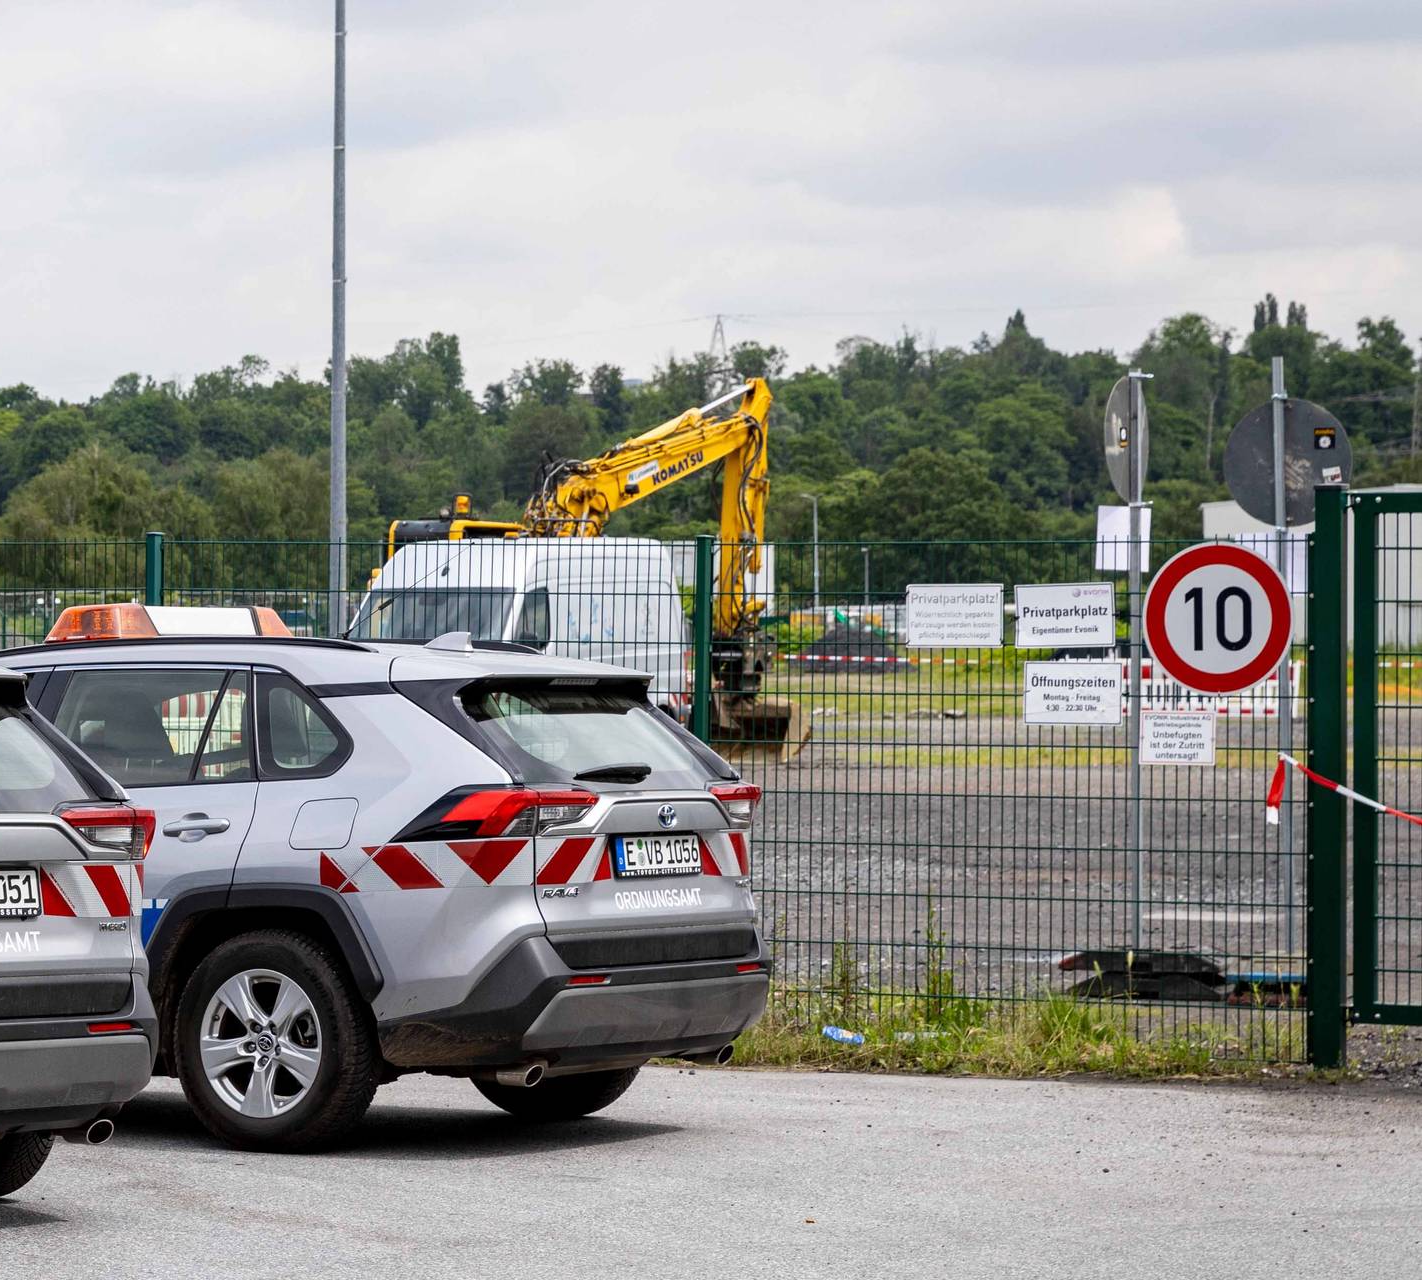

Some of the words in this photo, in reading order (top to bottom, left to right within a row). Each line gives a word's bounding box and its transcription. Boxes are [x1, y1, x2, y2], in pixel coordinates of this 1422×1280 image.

[652, 450, 704, 486] KOMATSU
[910, 592, 999, 606] Privatparkplatz!
[1022, 605, 1108, 620] Privatparkplatz
[1184, 586, 1252, 651] 10
[1032, 626, 1073, 636] Eigentümer
[1074, 625, 1099, 634] Evonik
[1031, 672, 1116, 690] Öffnungszeiten
[1043, 693, 1069, 702] Montag
[1076, 693, 1101, 702] Freitag
[1152, 731, 1203, 740] Unbefugten
[1155, 752, 1199, 761] untersagt!
[625, 841, 636, 866] E
[644, 840, 664, 865] VB
[666, 838, 699, 864] 1056
[541, 887, 579, 900] RAV4
[614, 887, 703, 910] ORDNUNGSAMT
